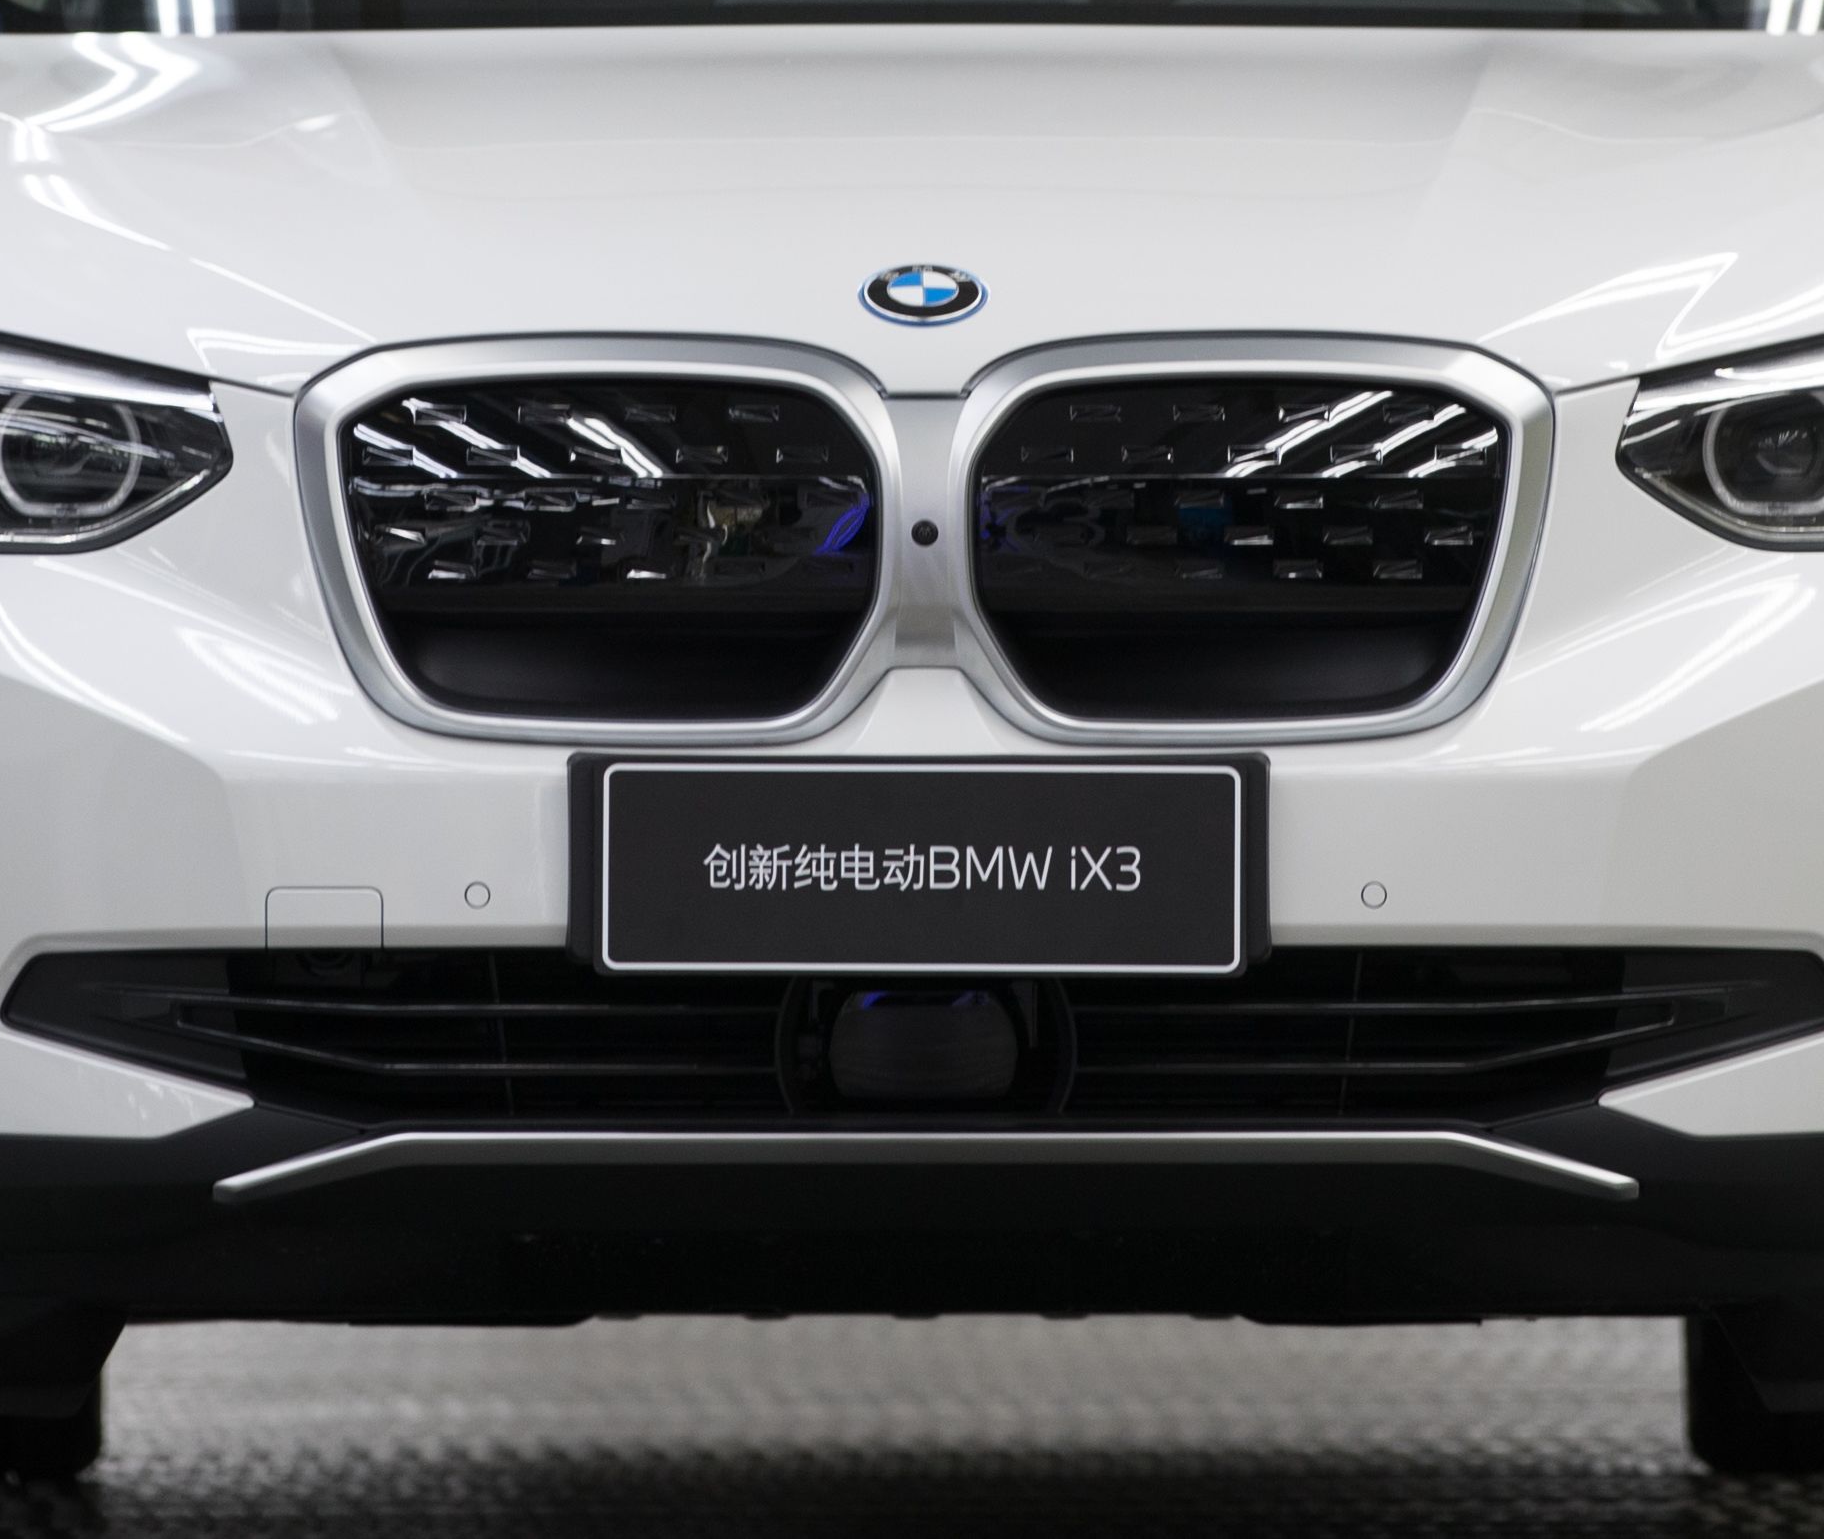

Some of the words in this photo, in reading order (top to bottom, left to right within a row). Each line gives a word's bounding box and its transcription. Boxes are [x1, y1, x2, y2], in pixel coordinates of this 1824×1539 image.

[703, 843, 1053, 891] 创新纯电动BMW
[1069, 845, 1141, 891] iX3
